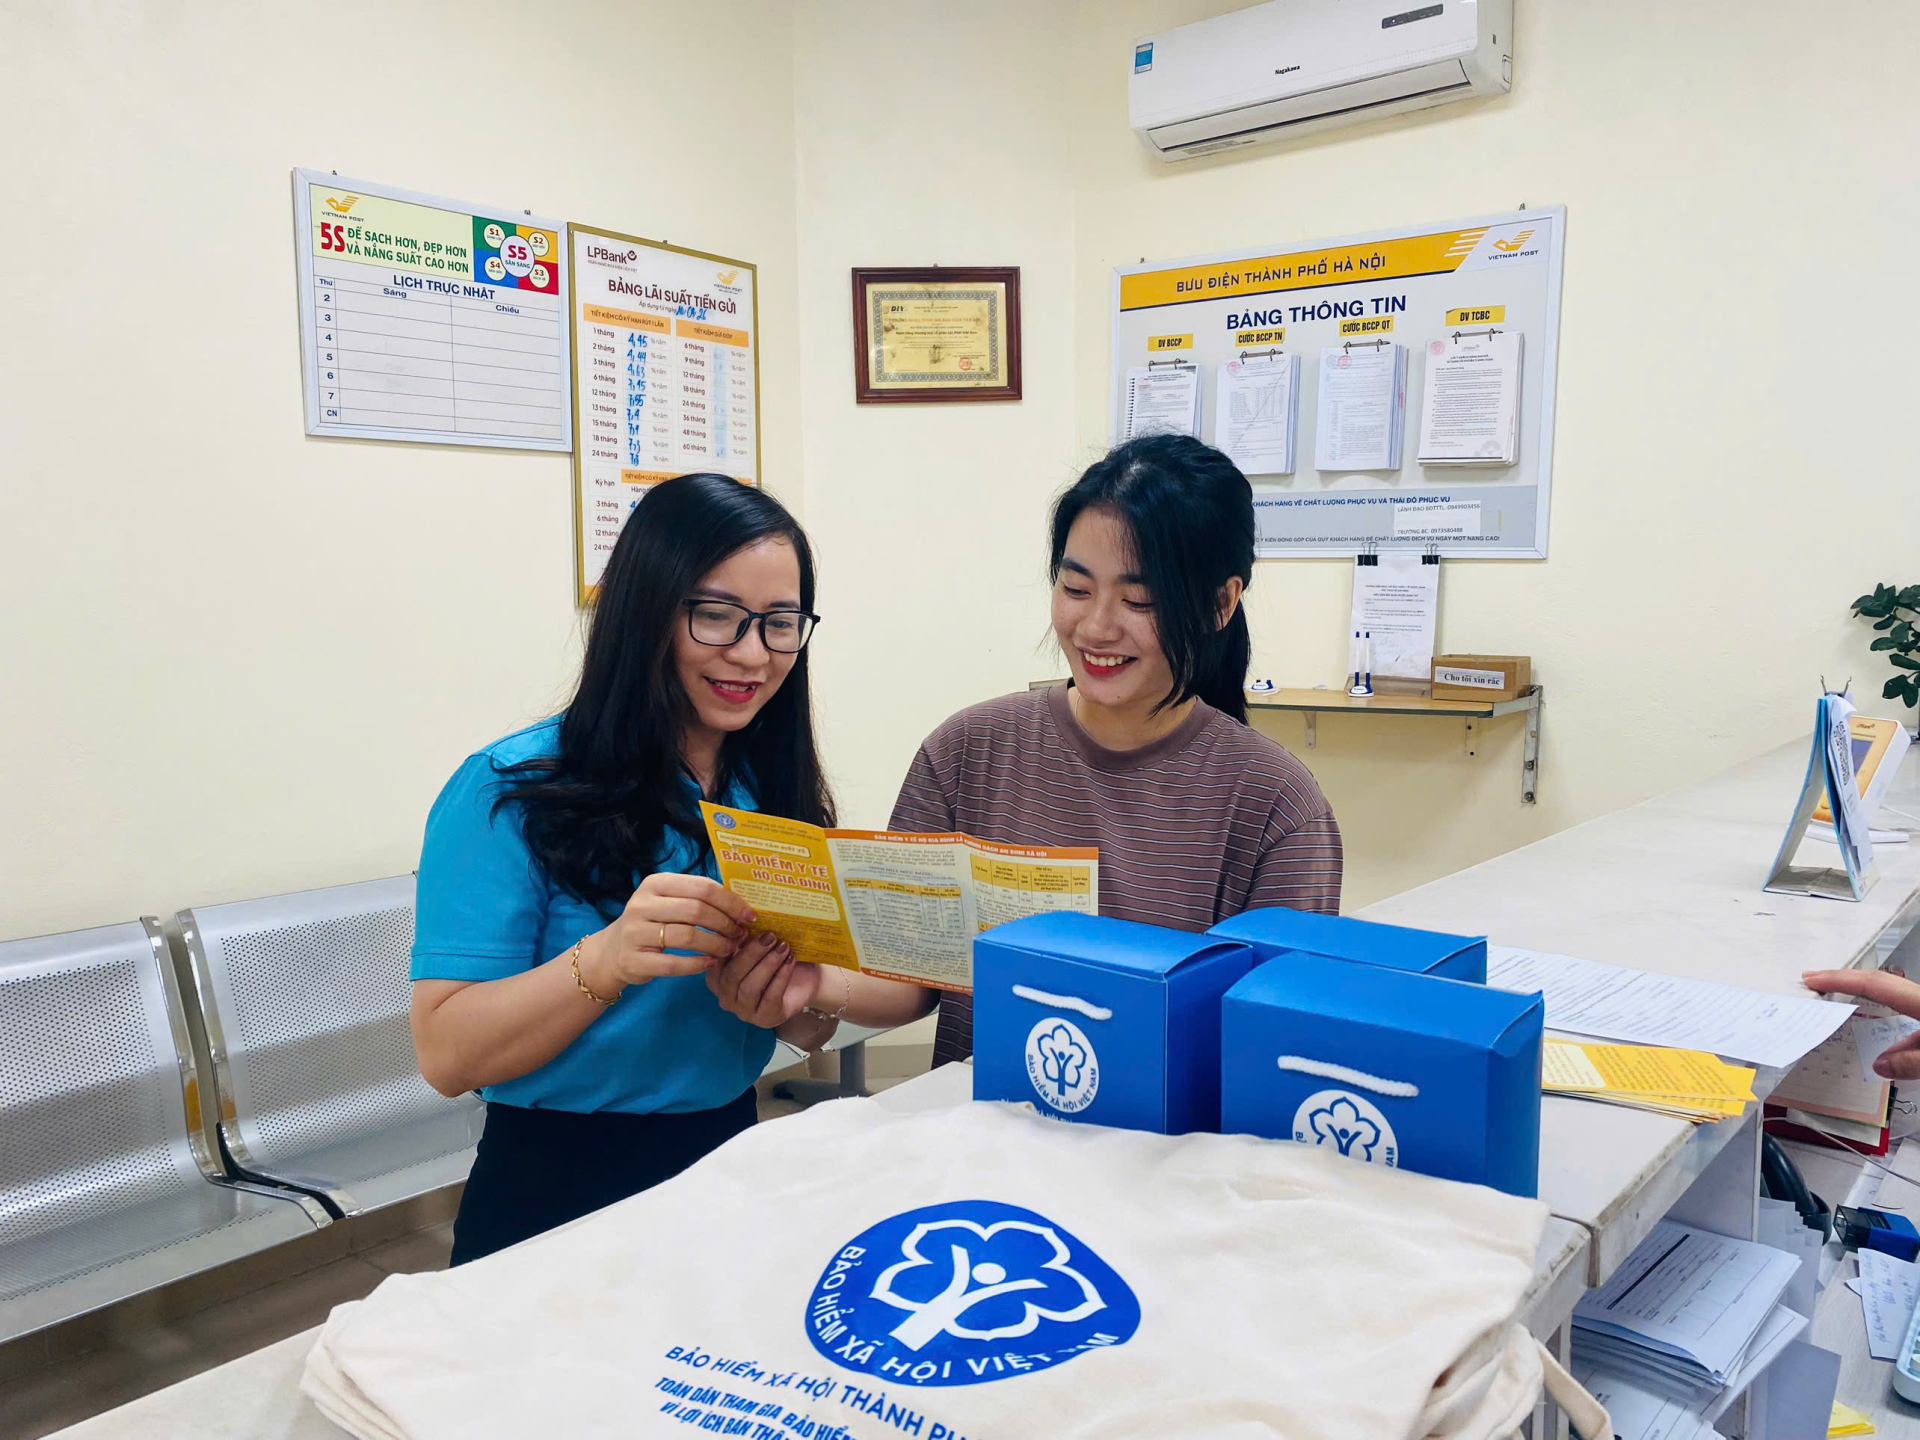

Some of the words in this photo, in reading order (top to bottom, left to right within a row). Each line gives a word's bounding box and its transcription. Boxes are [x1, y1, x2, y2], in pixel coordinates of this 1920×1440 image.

[1274, 66, 1300, 75] Nagakawa
[322, 211, 347, 220] VIETNAM
[320, 222, 346, 252] 5S
[490, 228, 500, 236] S1
[347, 226, 362, 240] ĐỂ
[396, 236, 420, 252] HƠN,
[424, 241, 442, 256] ĐẸP
[446, 245, 466, 258] HƠN
[534, 236, 544, 245] S2
[346, 240, 361, 256] VÀ
[396, 251, 422, 266] SUẤT
[425, 256, 444, 269] CAO
[448, 260, 468, 273] HƠN
[508, 244, 528, 260] S5
[587, 246, 628, 264] LPBank
[1488, 252, 1518, 260] VIETNAM
[490, 260, 500, 270] S4
[534, 268, 544, 277] S3
[1176, 278, 1202, 292] BƯU
[1208, 272, 1240, 289] ĐIỆN
[1244, 266, 1292, 284] THÀNH
[1298, 257, 1327, 277] PHỐ
[1333, 256, 1353, 272] HÀ
[1360, 252, 1386, 270] NỘI
[319, 278, 332, 286] Thứ
[393, 274, 423, 289] LỊCH
[426, 280, 460, 295] TRỰC
[464, 286, 495, 300] NHẬT
[324, 293, 330, 302] 2
[383, 288, 407, 298] Sáng
[608, 276, 643, 296] BẢNG
[645, 284, 662, 300] LÃI
[664, 289, 692, 306] SUẤT
[718, 298, 736, 314] GỬI
[496, 304, 520, 314] Chiều
[1226, 308, 1283, 330] BẢNG
[1288, 300, 1364, 323] THÔNG
[1370, 295, 1406, 314] TIN
[324, 314, 331, 322] 3
[1460, 312, 1470, 322] DV
[1471, 310, 1490, 320] TCBC
[1342, 322, 1361, 333] CƯỚC
[1362, 320, 1380, 331] BCCP
[1381, 320, 1390, 330] QT
[325, 334, 332, 342] 4
[597, 328, 615, 338] tháng
[1238, 332, 1255, 344] CƯỚC
[1256, 332, 1273, 342] BCCP
[1274, 331, 1283, 341] TN
[1158, 339, 1166, 348] DV
[1167, 338, 1182, 347] BCCP
[598, 344, 615, 354] tháng
[326, 353, 333, 362] 5
[598, 360, 616, 369] tháng
[327, 372, 334, 380] 6
[598, 375, 616, 384] tháng
[328, 392, 334, 400] 7
[599, 390, 616, 399] tháng
[326, 408, 338, 418] CN
[599, 405, 616, 414] tháng
[600, 420, 617, 429] tháng
[600, 436, 618, 444] tháng
[601, 450, 618, 459] tháng
[601, 501, 619, 509] tháng
[1444, 673, 1460, 681] Cho
[1474, 676, 1485, 684] xin
[722, 845, 751, 864] BẢO
[755, 854, 794, 872] HIỂM
[797, 862, 806, 873] Y
[809, 864, 829, 878] TẾ
[752, 868, 770, 883] HỘ
[774, 874, 796, 886] GIA
[1028, 1054, 1036, 1074] BẢO
[1032, 1075, 1049, 1099] HIỂM
[1050, 1096, 1060, 1107] XÃ
[1063, 1101, 1077, 1111] HỘI
[1078, 1088, 1093, 1107] VIỆT
[822, 1246, 867, 1290] BẢO
[812, 1292, 855, 1344] HIỂM
[834, 1334, 884, 1364] XÃ
[966, 1352, 1052, 1376] VIỆT
[880, 1356, 952, 1384] HỘI
[664, 1346, 710, 1368] BẢO
[710, 1358, 766, 1382] HIỂM
[763, 1372, 799, 1388] XÃ
[796, 1376, 838, 1402] HỘI
[839, 1384, 924, 1436] THÀNH
[654, 1376, 694, 1399] TOÀN
[718, 1393, 760, 1414] THAM
[756, 1402, 784, 1420] GIA
[781, 1412, 816, 1438] BẢO
[698, 1409, 726, 1432] ÍCH
